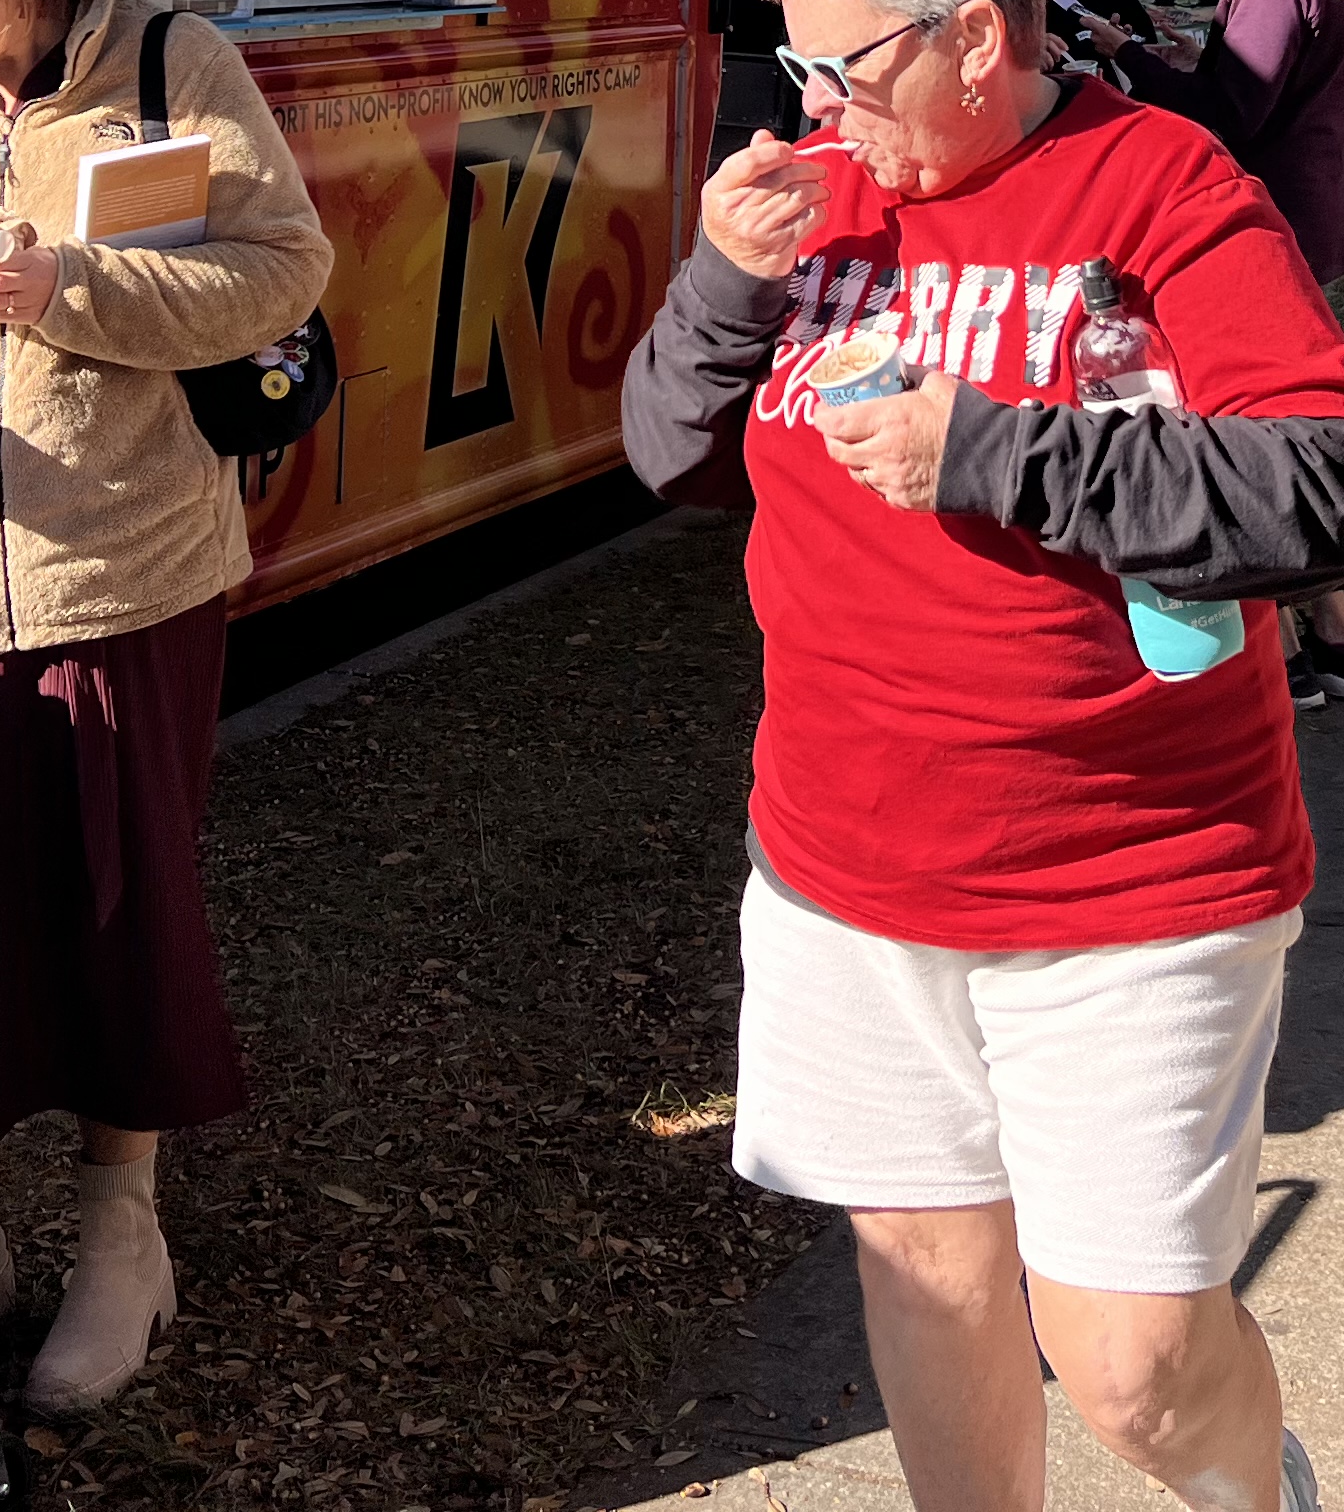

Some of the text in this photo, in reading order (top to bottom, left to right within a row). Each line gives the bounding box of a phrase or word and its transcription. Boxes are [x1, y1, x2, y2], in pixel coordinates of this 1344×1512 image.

[272, 64, 641, 136] ORT HIS NON-PROFIT KNOW YOUR RIGHTS CAMP
